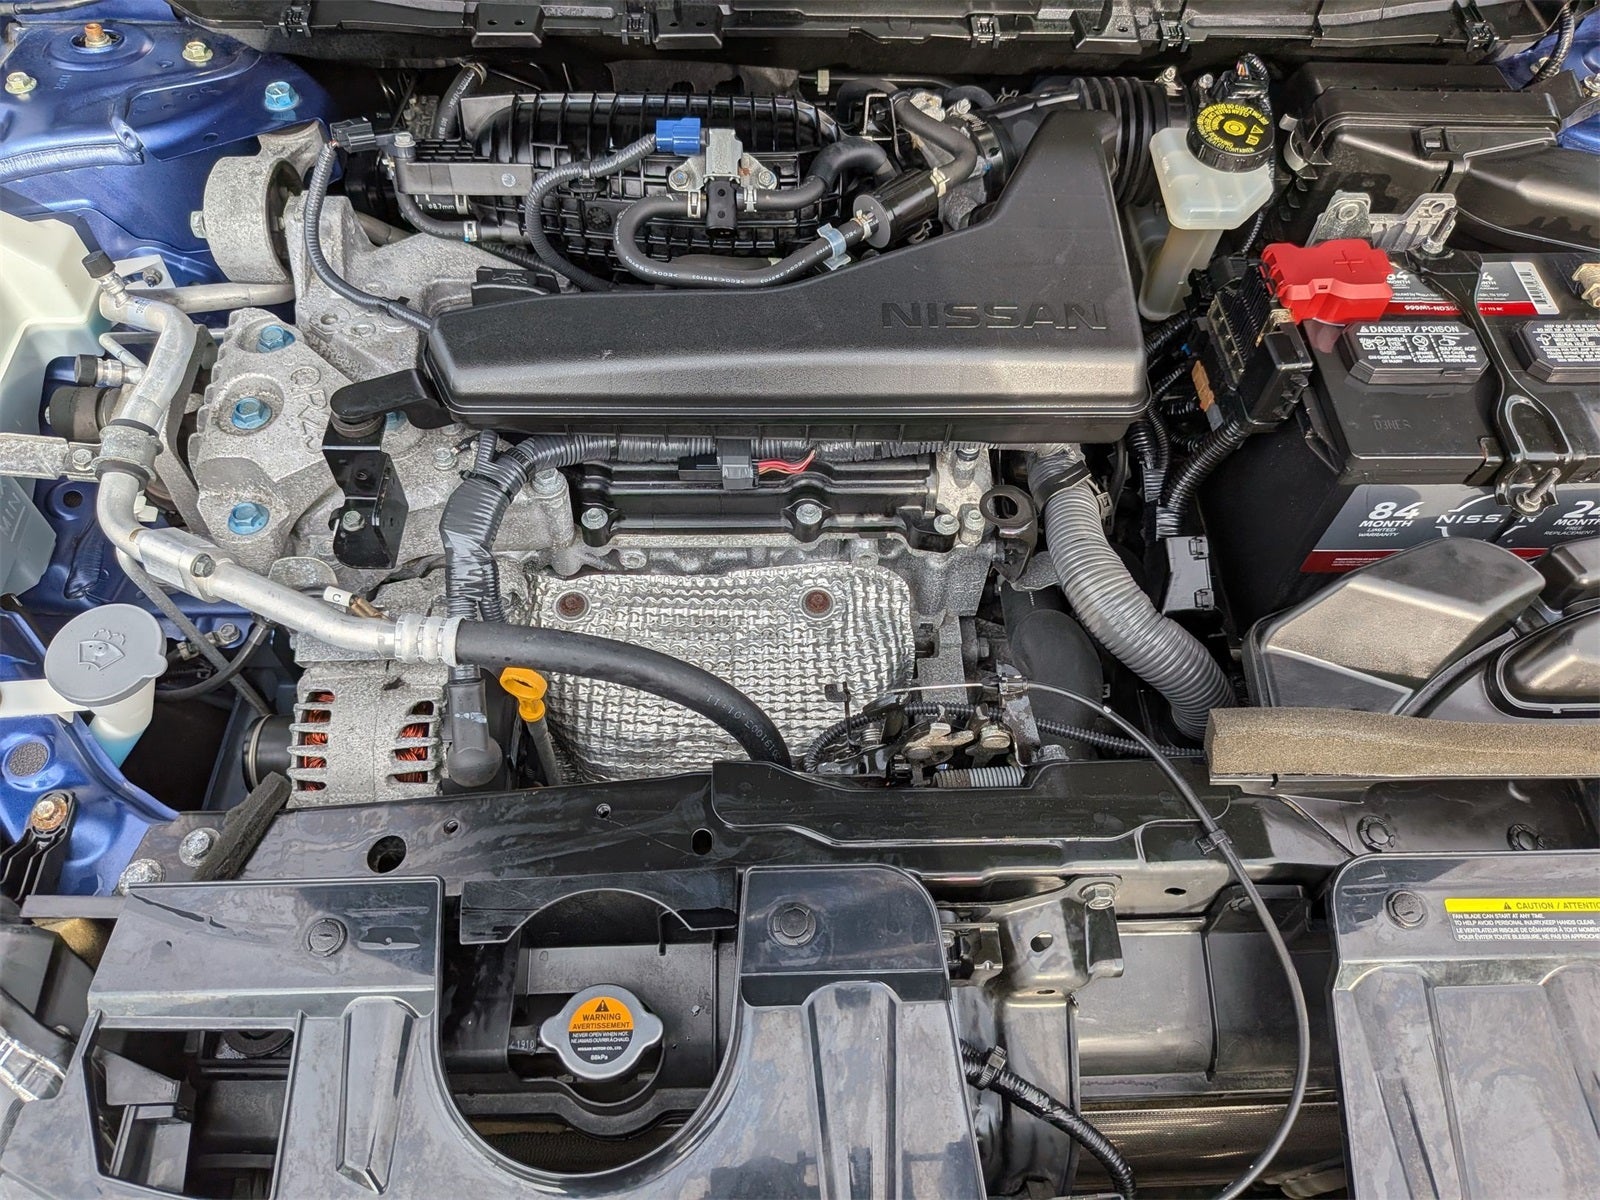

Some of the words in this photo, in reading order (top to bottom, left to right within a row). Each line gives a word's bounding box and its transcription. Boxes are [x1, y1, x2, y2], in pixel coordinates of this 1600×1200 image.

[881, 302, 1108, 331] NISSAN
[1369, 325, 1412, 333] DANGER
[1421, 325, 1460, 333] POISON
[1368, 501, 1425, 520] 84
[1435, 514, 1537, 524] NISSN
[1358, 520, 1415, 528] MONTH
[332, 593, 342, 603] C
[1515, 901, 1554, 910] CAUTION
[582, 1013, 621, 1021] WARNING
[571, 1021, 630, 1030] AVERTISSEMENT
